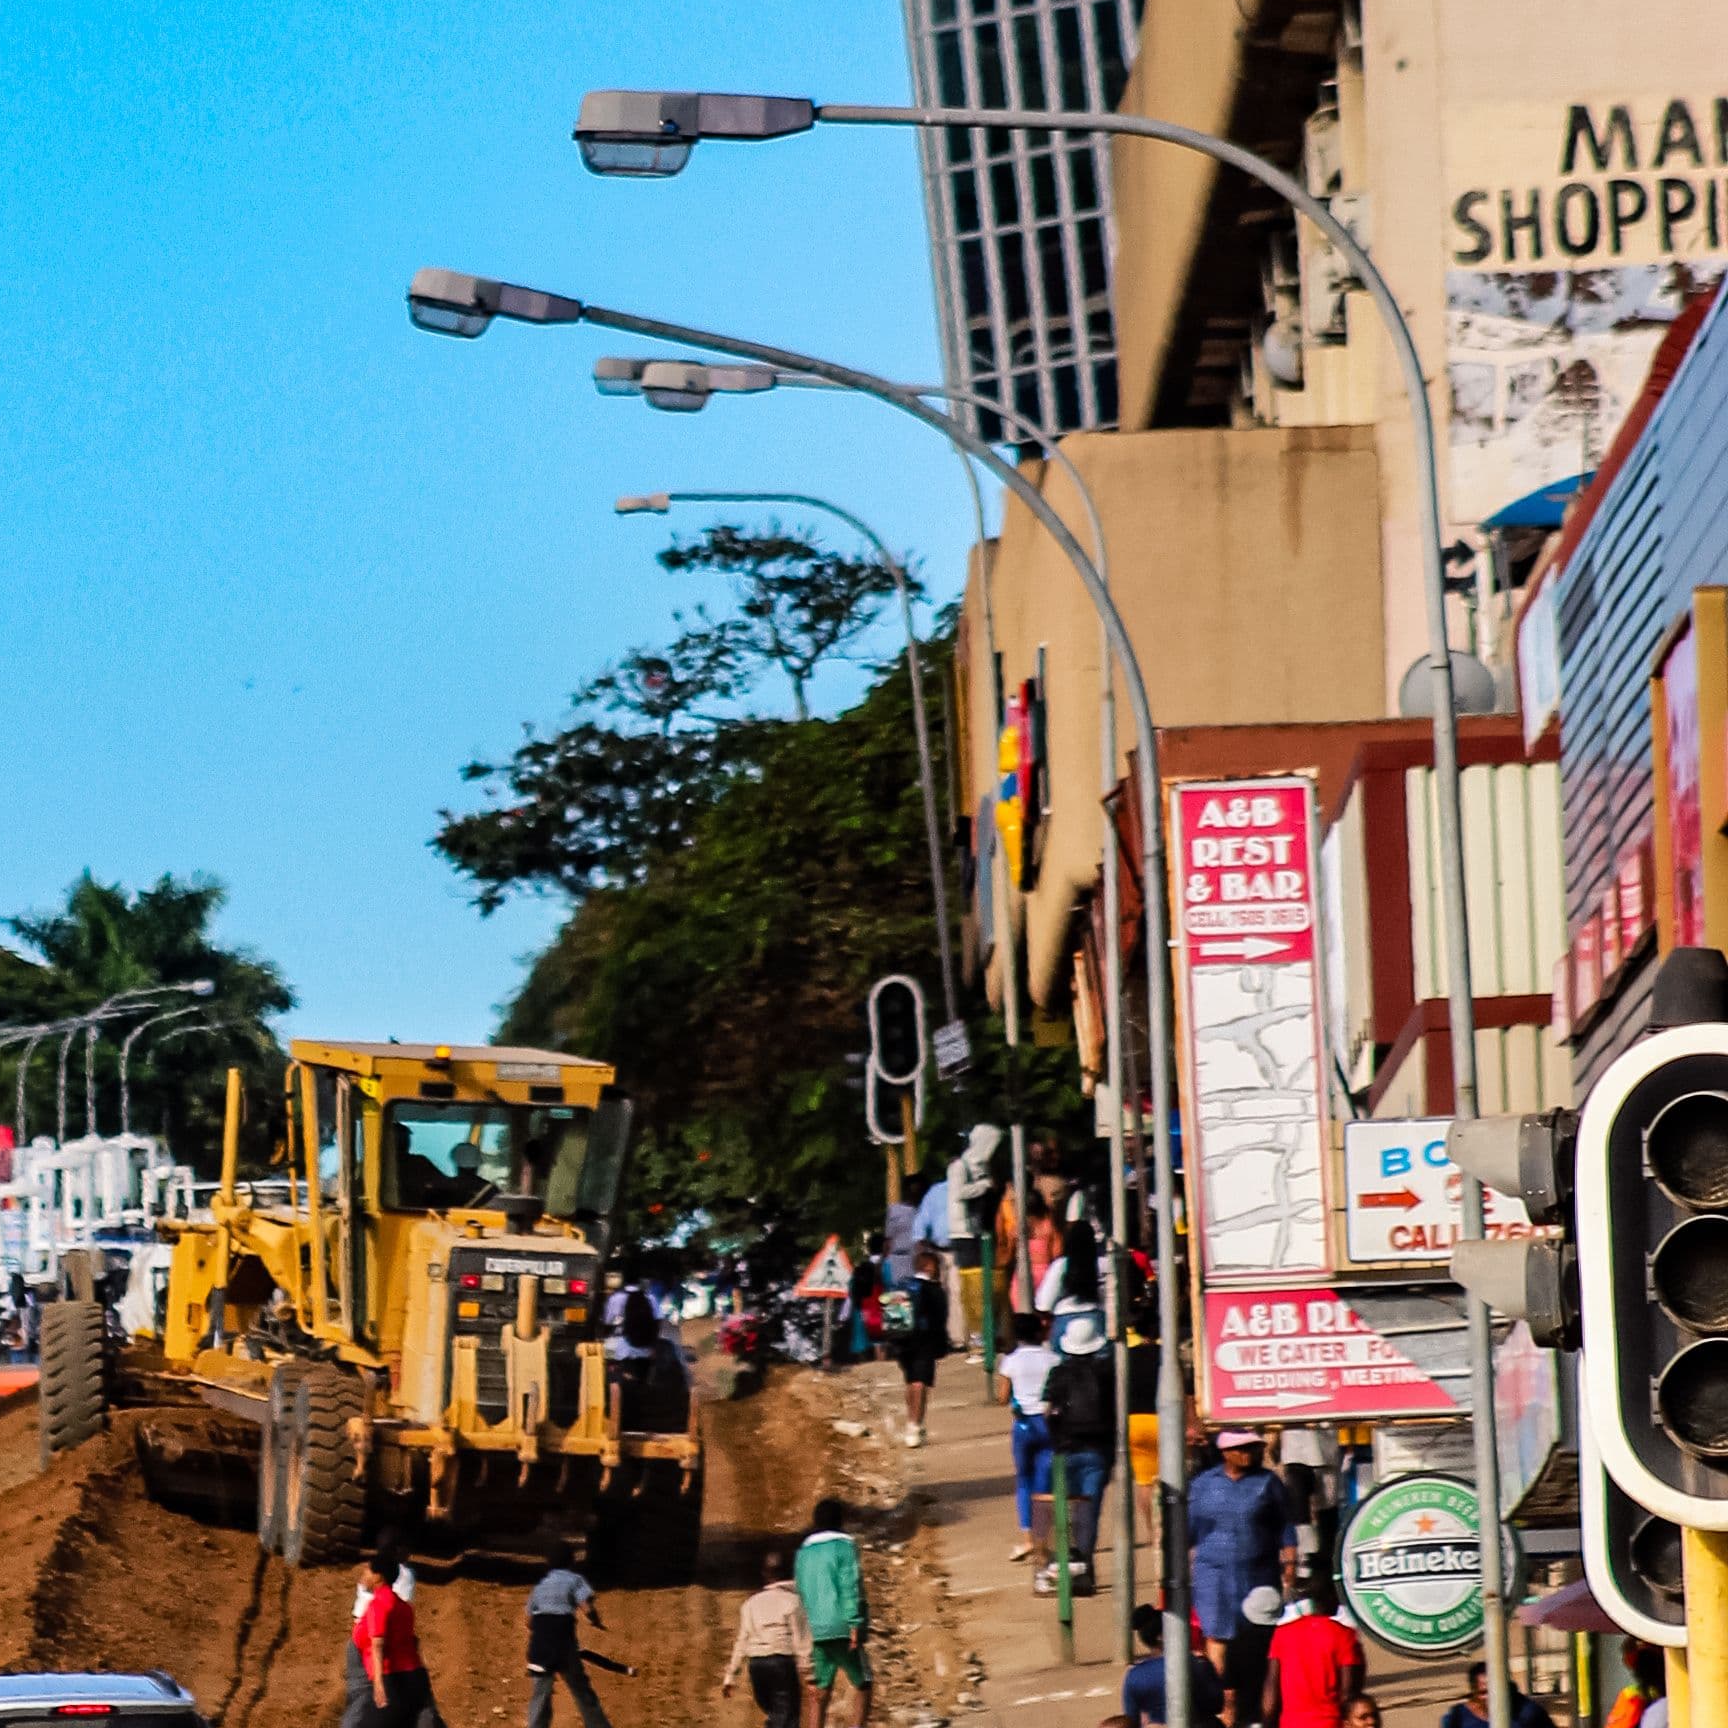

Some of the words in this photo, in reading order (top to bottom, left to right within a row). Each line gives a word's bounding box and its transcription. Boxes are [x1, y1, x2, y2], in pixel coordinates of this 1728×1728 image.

[1560, 97, 1728, 175] MA
[1452, 178, 1728, 264] SHOPPI
[1197, 796, 1283, 829] A&B
[1191, 835, 1295, 868] REST
[1185, 873, 1213, 903] &
[1220, 870, 1305, 902] BAR
[1220, 1302, 1301, 1338] A&B
[1235, 1344, 1271, 1367] WE
[1277, 1342, 1346, 1366] CATER
[1367, 1340, 1404, 1362] FO
[1357, 1544, 1481, 1579] Heineke
